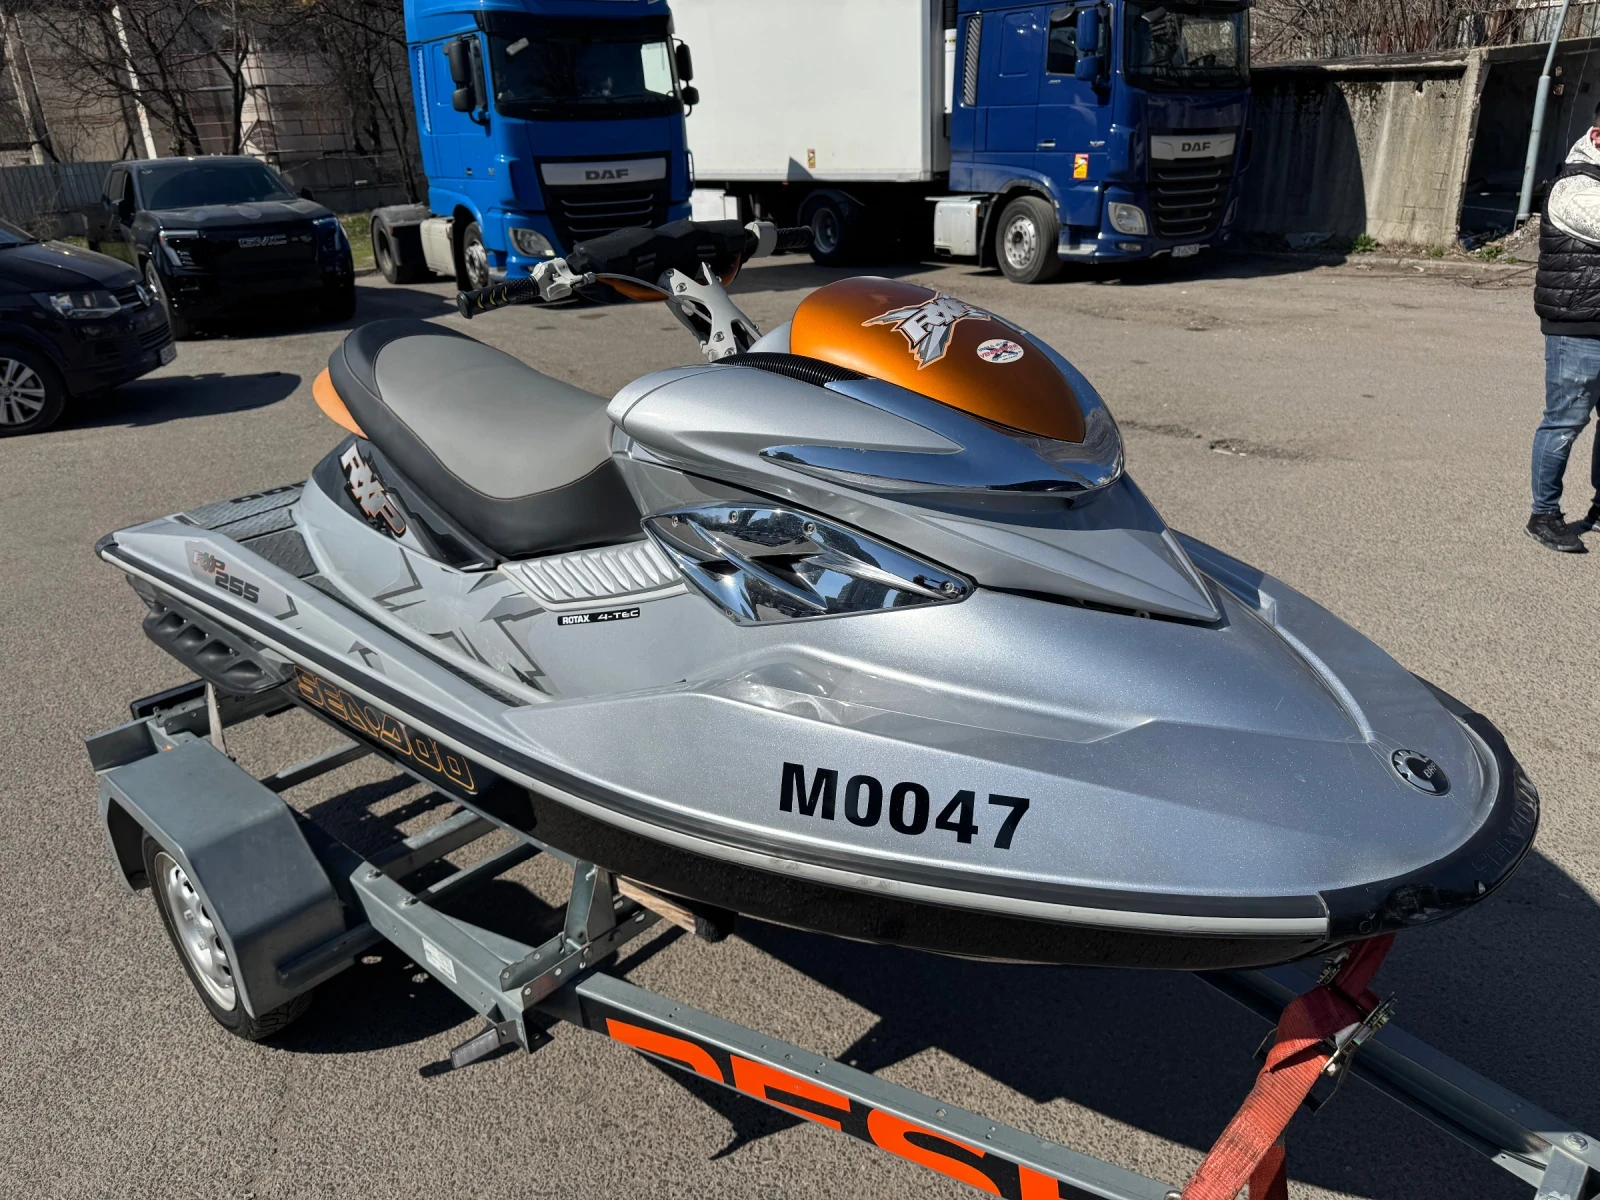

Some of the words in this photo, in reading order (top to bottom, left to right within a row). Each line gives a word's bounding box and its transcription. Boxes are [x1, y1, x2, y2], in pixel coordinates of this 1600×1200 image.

[1182, 142, 1211, 153] DAF
[585, 169, 629, 181] DAF
[238, 234, 287, 248] GMC
[214, 571, 260, 604] 255
[562, 614, 591, 625] ROTAX
[597, 610, 639, 620] 4-TEC
[1423, 762, 1437, 778] BRP
[779, 762, 1030, 850] M0047
